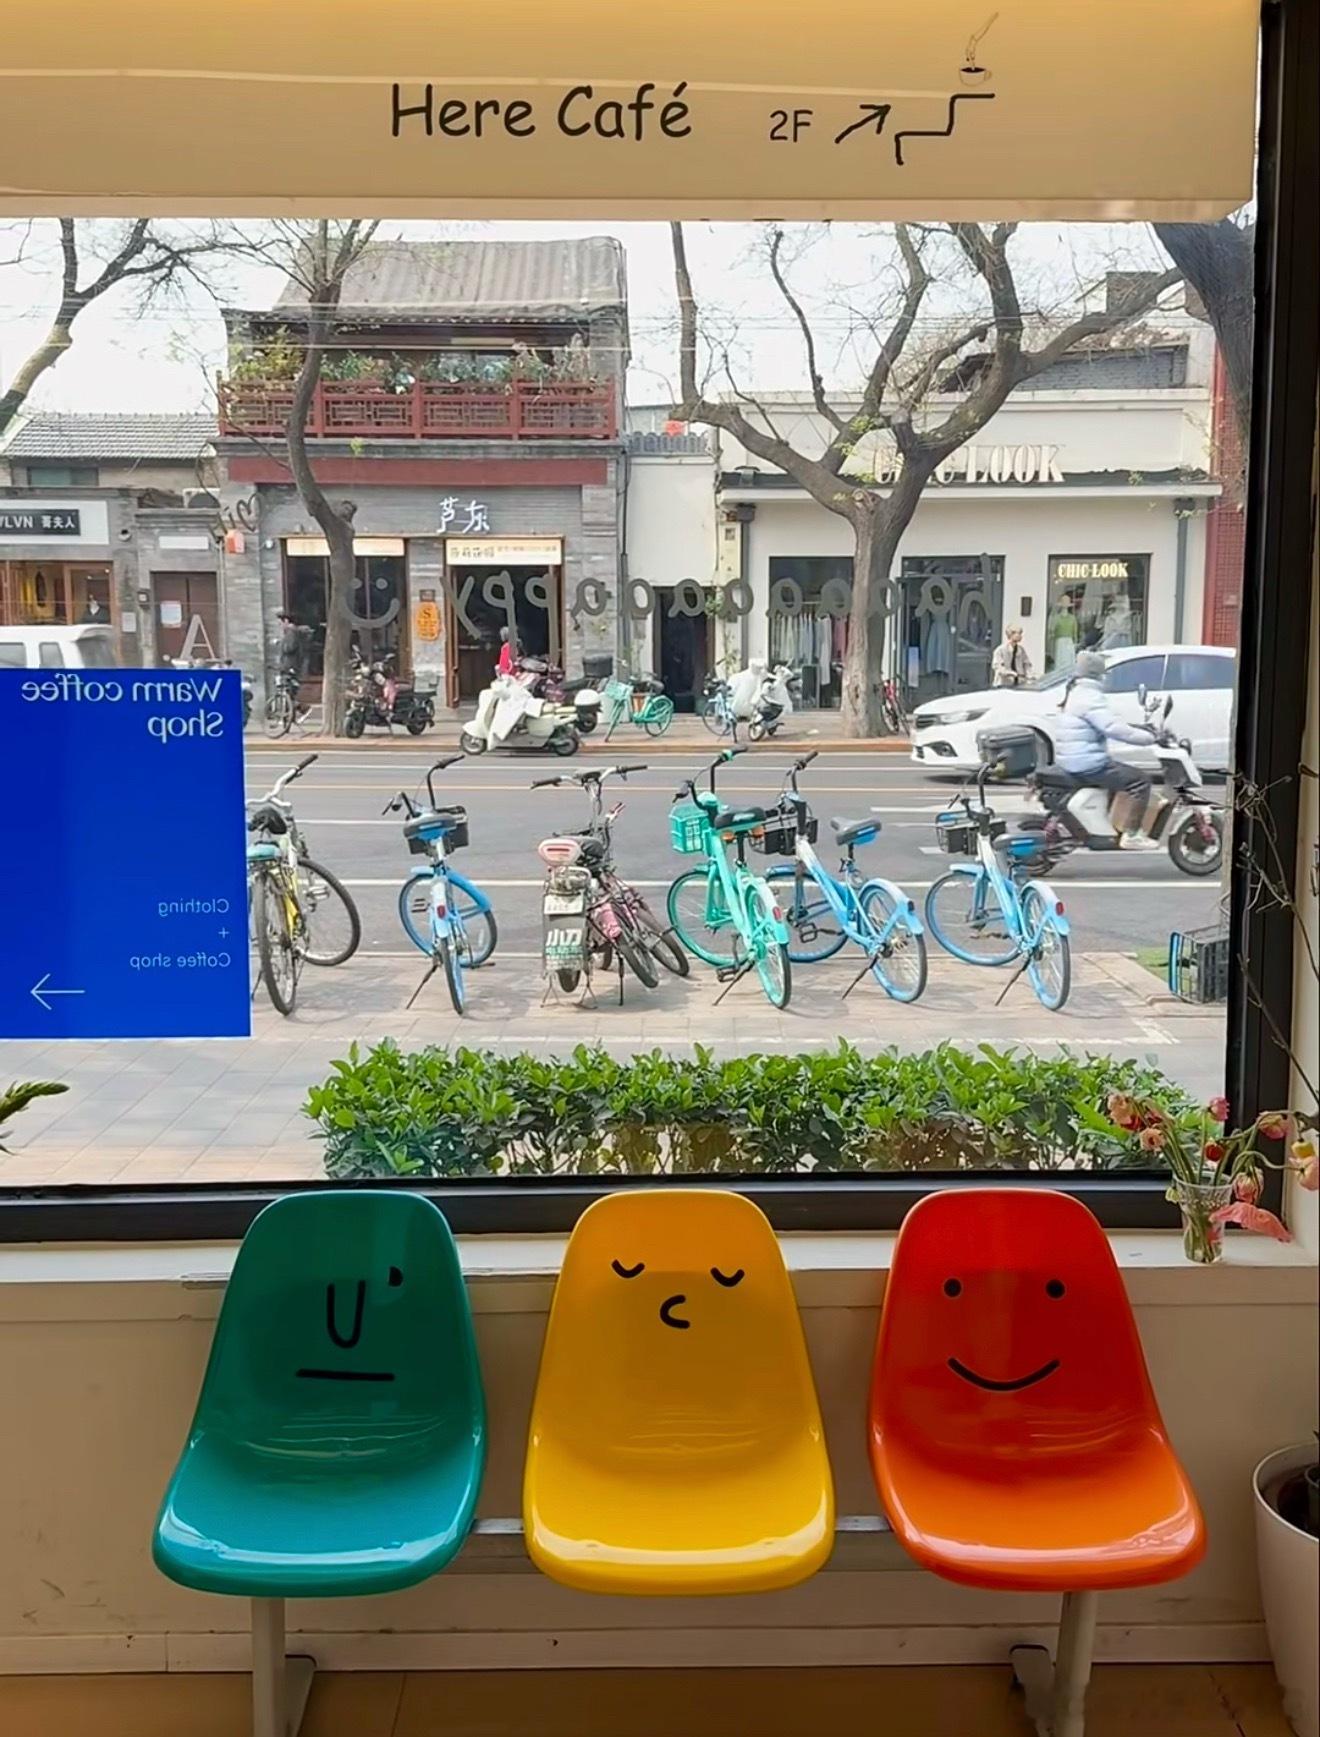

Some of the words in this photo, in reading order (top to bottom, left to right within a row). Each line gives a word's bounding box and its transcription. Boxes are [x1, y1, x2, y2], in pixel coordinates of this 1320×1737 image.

[392, 83, 535, 137] Here
[557, 81, 692, 141] Café
[769, 109, 814, 142] 2F
[964, 444, 1066, 484] LOOK
[1058, 563, 1089, 578] CHIC
[1092, 562, 1128, 578] LOOK
